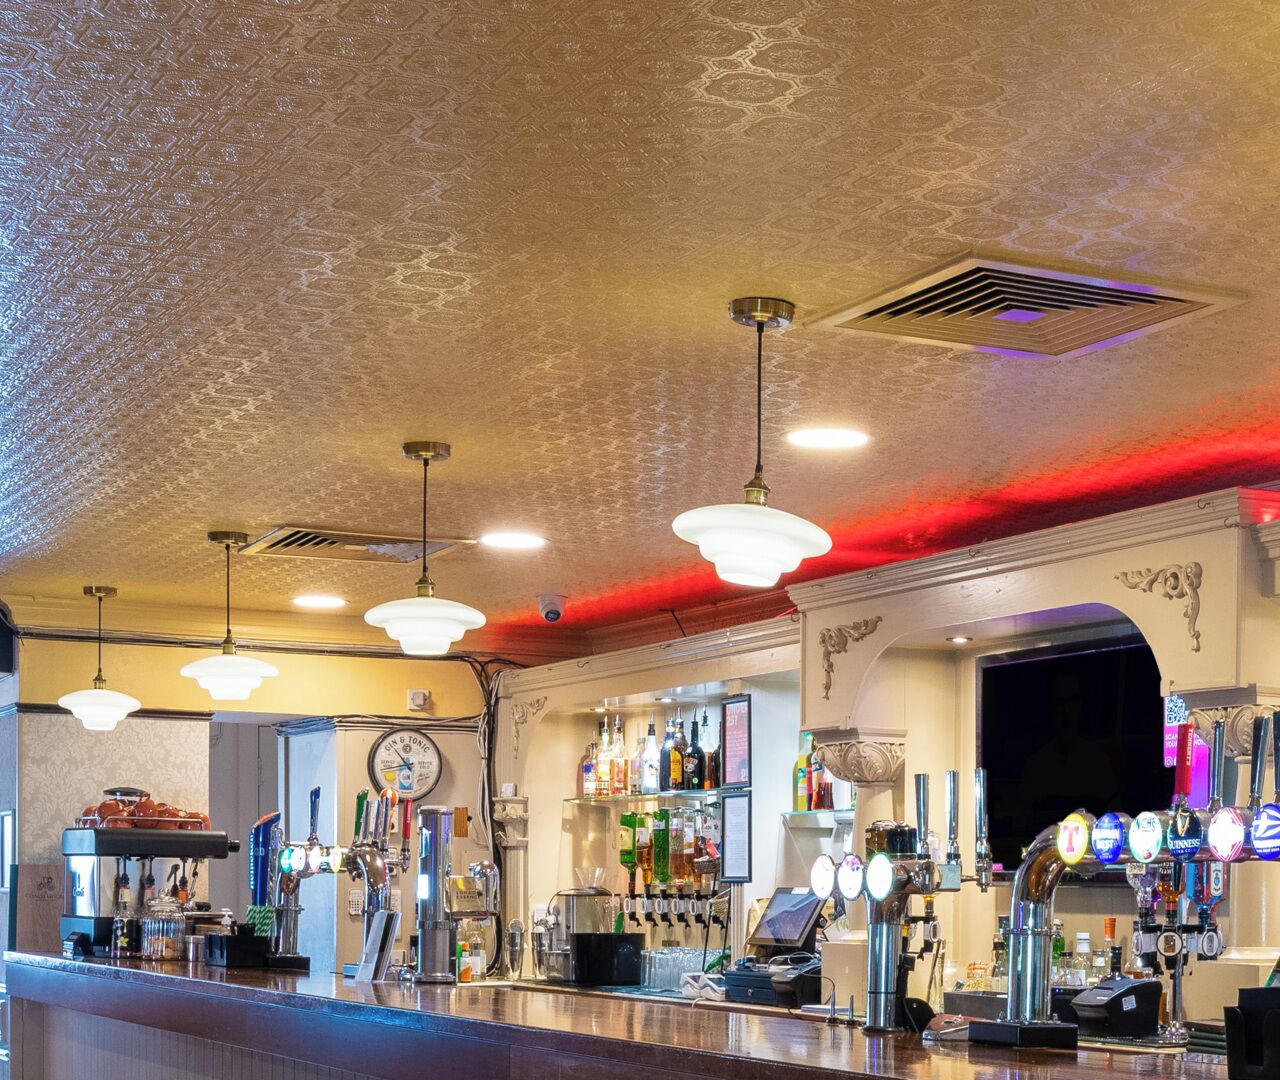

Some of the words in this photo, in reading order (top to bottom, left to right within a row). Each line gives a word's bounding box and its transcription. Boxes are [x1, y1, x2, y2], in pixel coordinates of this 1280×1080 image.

[384, 738, 398, 752] GIN
[408, 735, 431, 753] TONIC
[1063, 824, 1080, 853] T
[1168, 838, 1201, 850] GUINNESS
